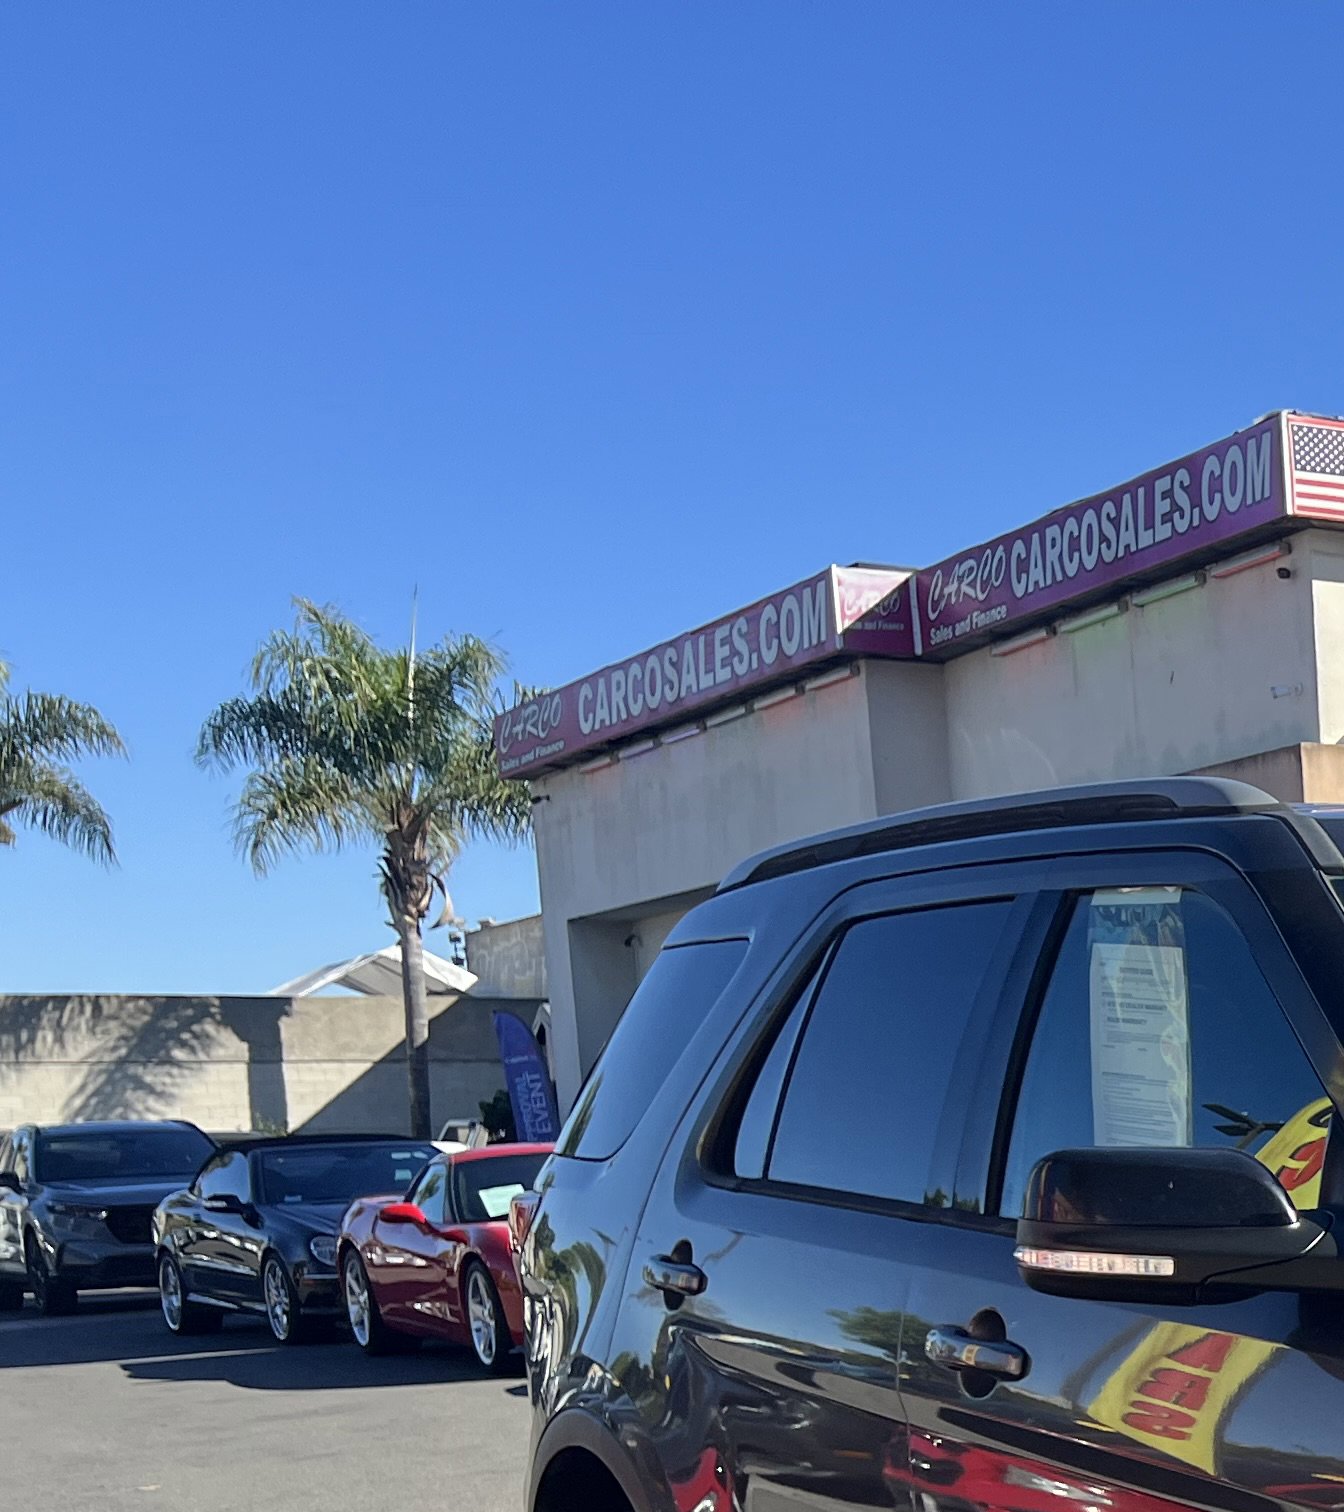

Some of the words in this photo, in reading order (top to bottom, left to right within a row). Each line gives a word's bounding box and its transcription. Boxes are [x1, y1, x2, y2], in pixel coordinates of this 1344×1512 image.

[927, 545, 1007, 621] CARCO
[1010, 431, 1271, 599] CARCOSALES.COM
[499, 693, 563, 754] CARCO
[577, 579, 827, 736] CARCOSALES.COM
[930, 623, 954, 646] Sales
[954, 616, 971, 640] and
[973, 605, 1007, 630] Finance
[528, 1073, 552, 1134] EVENT
